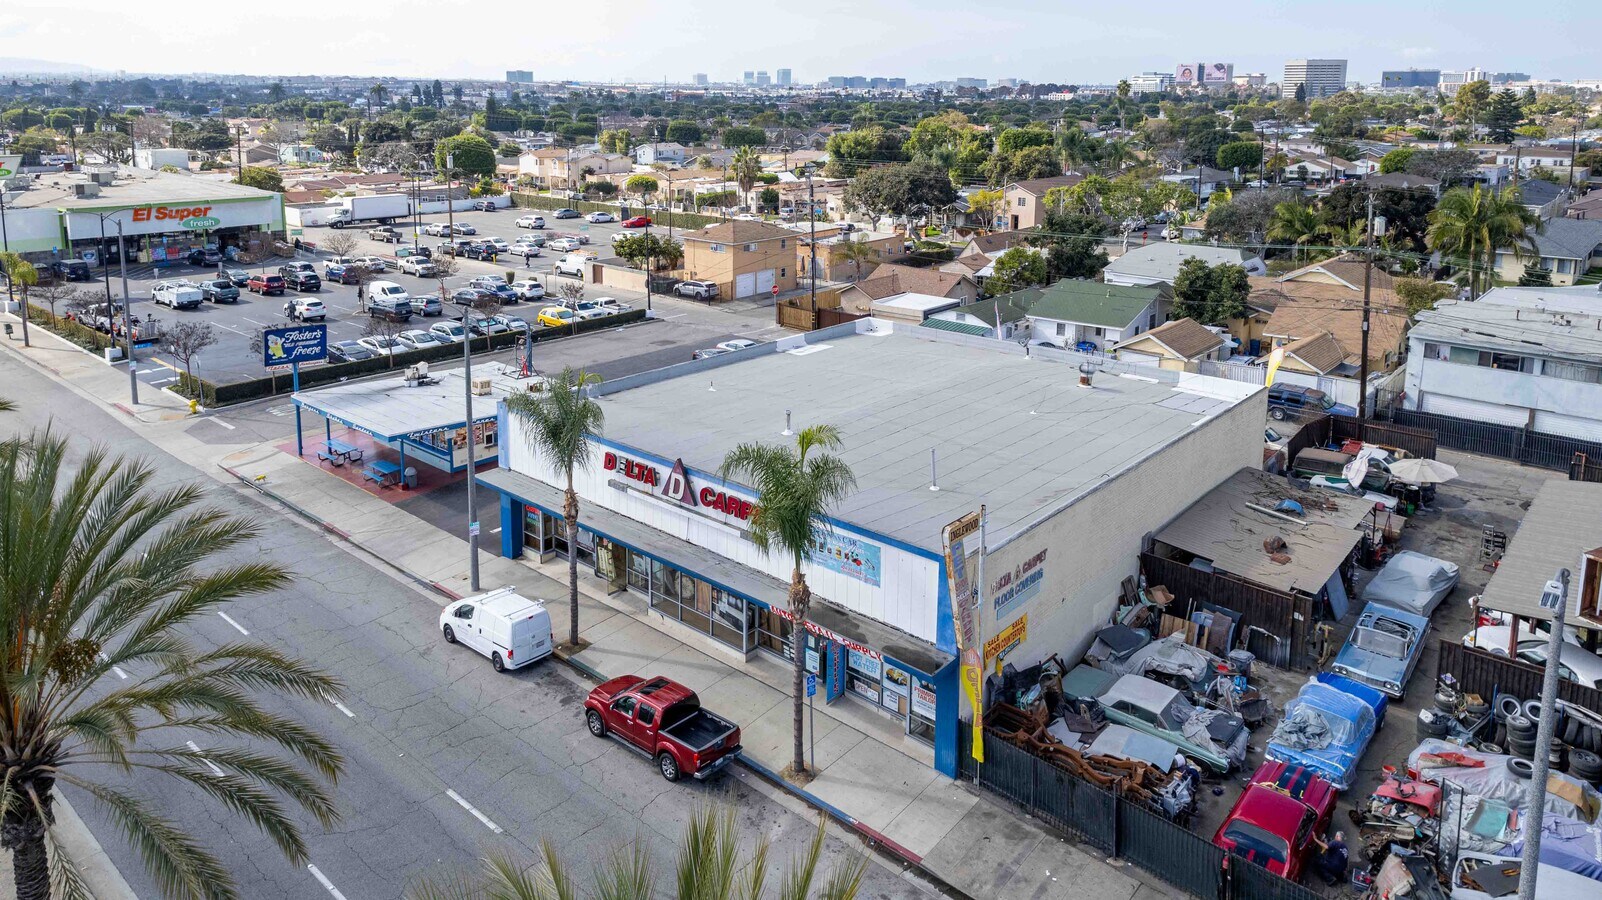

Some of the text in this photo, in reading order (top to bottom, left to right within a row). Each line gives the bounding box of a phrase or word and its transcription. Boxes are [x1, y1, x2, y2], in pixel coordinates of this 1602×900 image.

[132, 206, 212, 222] El Super
[190, 219, 215, 228] fresh
[284, 329, 322, 342] Foster's
[289, 346, 321, 359] freeze
[604, 452, 657, 487] DELTA
[950, 518, 979, 542] INGLEWOOD
[952, 541, 964, 579] PET
[1023, 548, 1048, 574] CARPET
[994, 567, 1043, 610] FLOOR COVERING
[771, 604, 794, 622] AUTO
[842, 639, 883, 661] SUPPLY
[987, 617, 1024, 648] SALE SALE
[849, 652, 879, 669] SPOT FREE
[985, 643, 1001, 661] KITCHEN
[853, 659, 877, 674] WATER
[855, 681, 868, 694] OPEN
